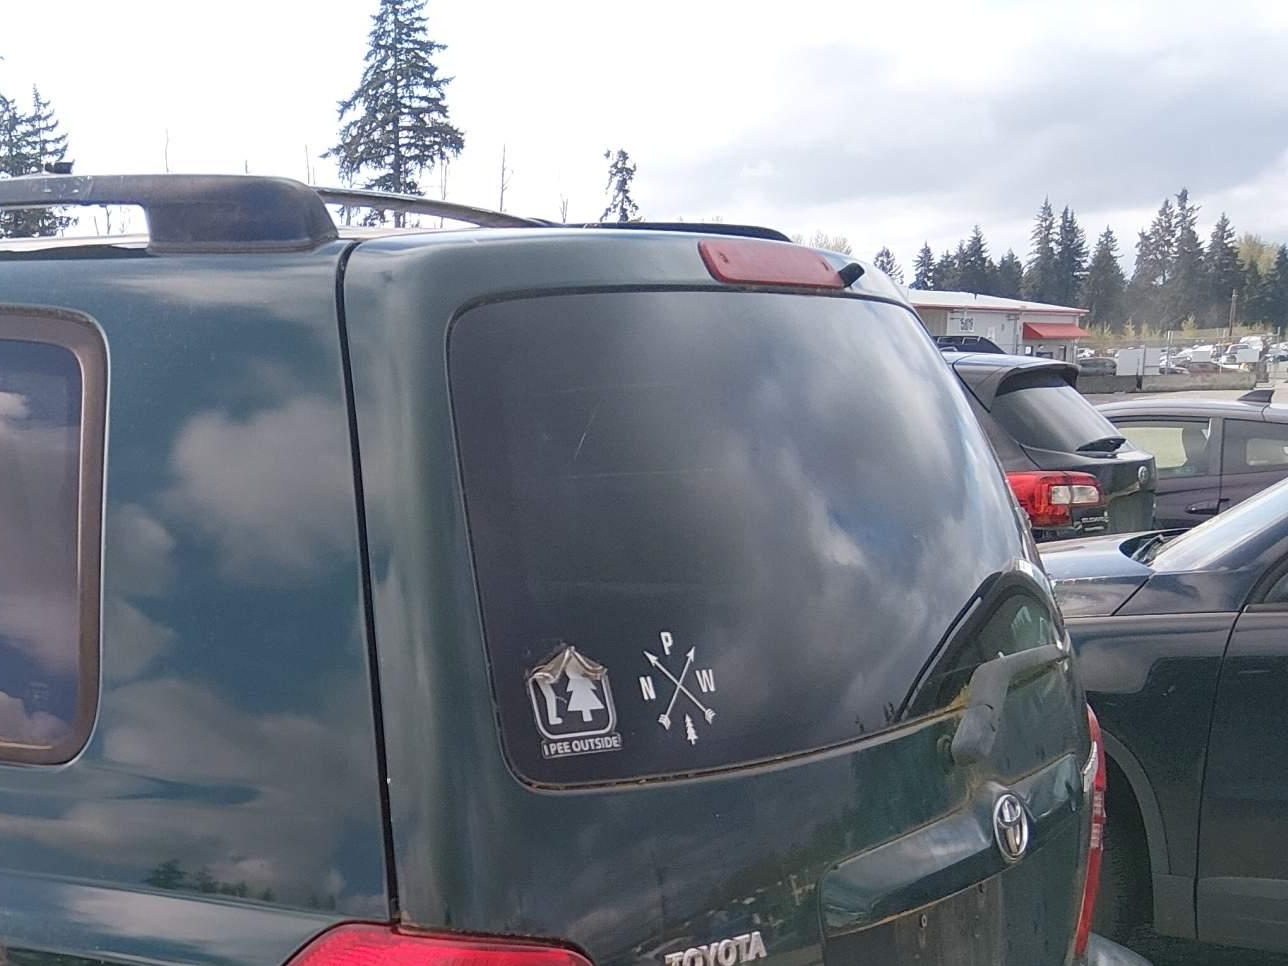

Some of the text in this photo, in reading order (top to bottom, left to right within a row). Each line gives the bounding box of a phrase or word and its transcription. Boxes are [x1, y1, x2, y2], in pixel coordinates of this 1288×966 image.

[660, 631, 673, 655] P
[639, 675, 656, 700] N
[695, 669, 715, 692] W
[549, 741, 571, 755] PEE
[571, 736, 621, 752] OUTSIDE
